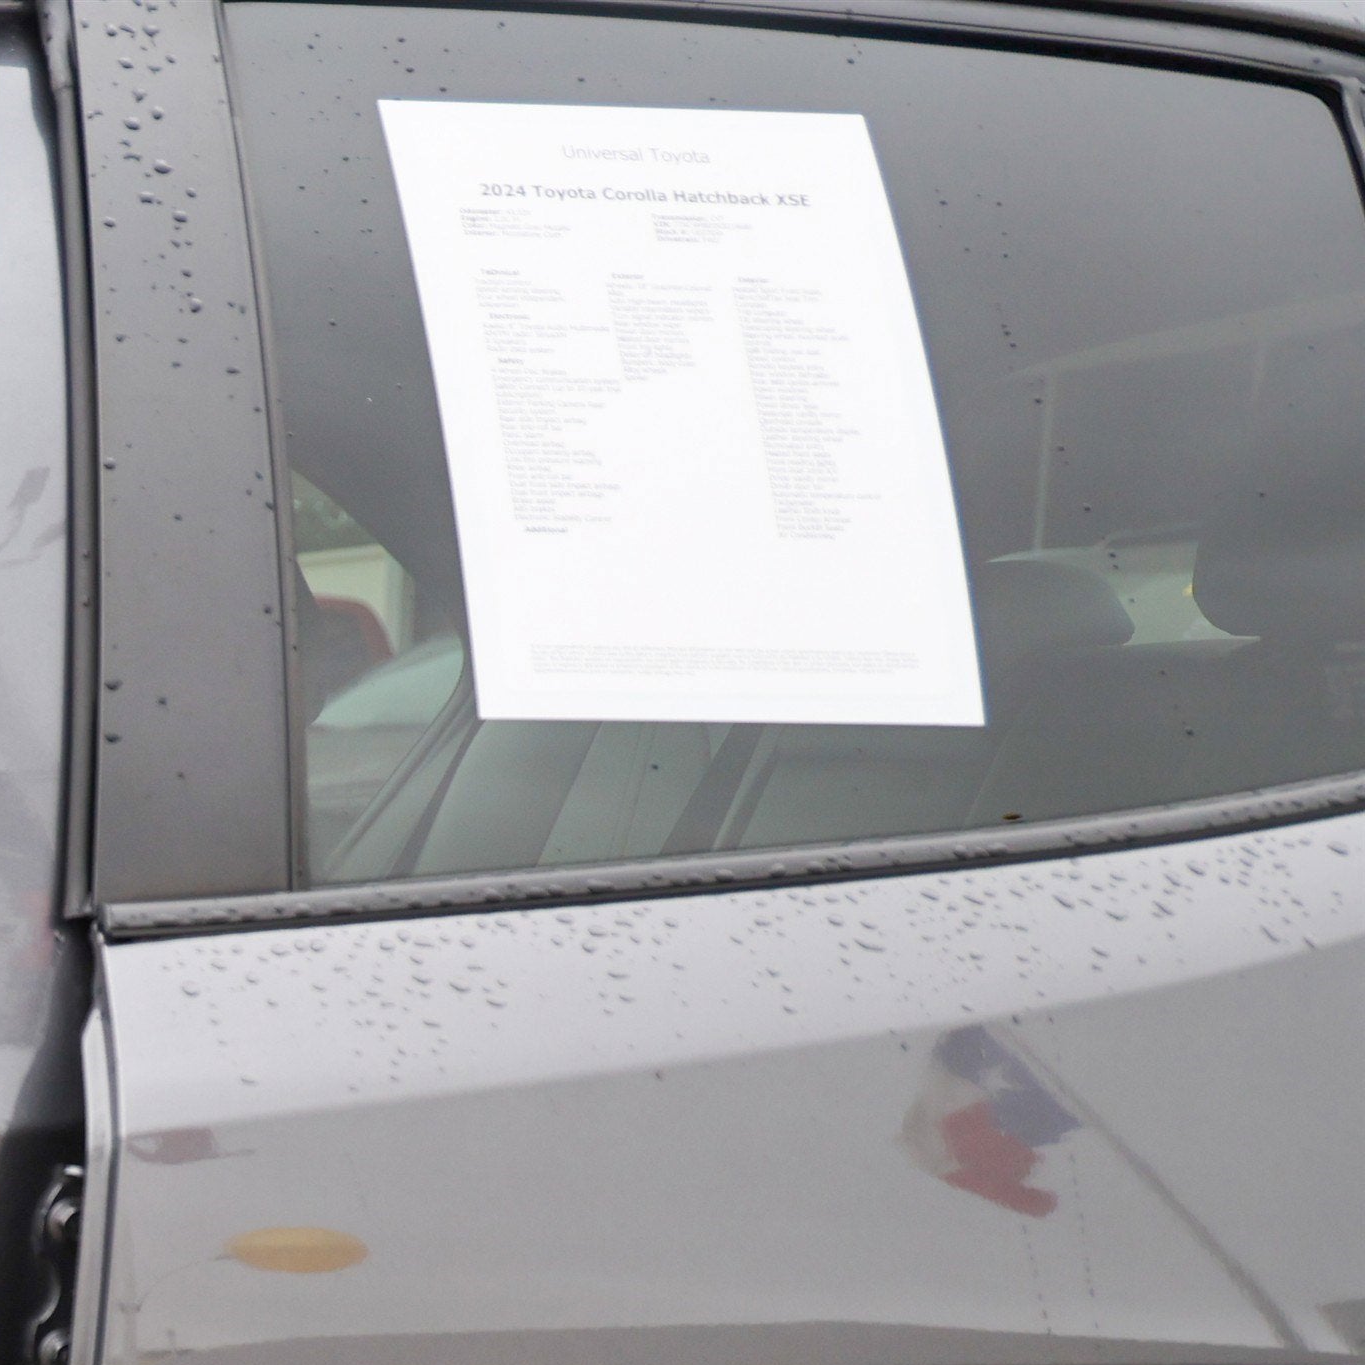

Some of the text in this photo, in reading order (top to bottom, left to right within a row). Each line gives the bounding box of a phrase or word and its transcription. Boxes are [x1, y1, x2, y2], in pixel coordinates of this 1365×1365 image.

[562, 145, 710, 164] Universal Toyota
[480, 183, 811, 207] 2024 Toyota Corolla Hatchback XSE
